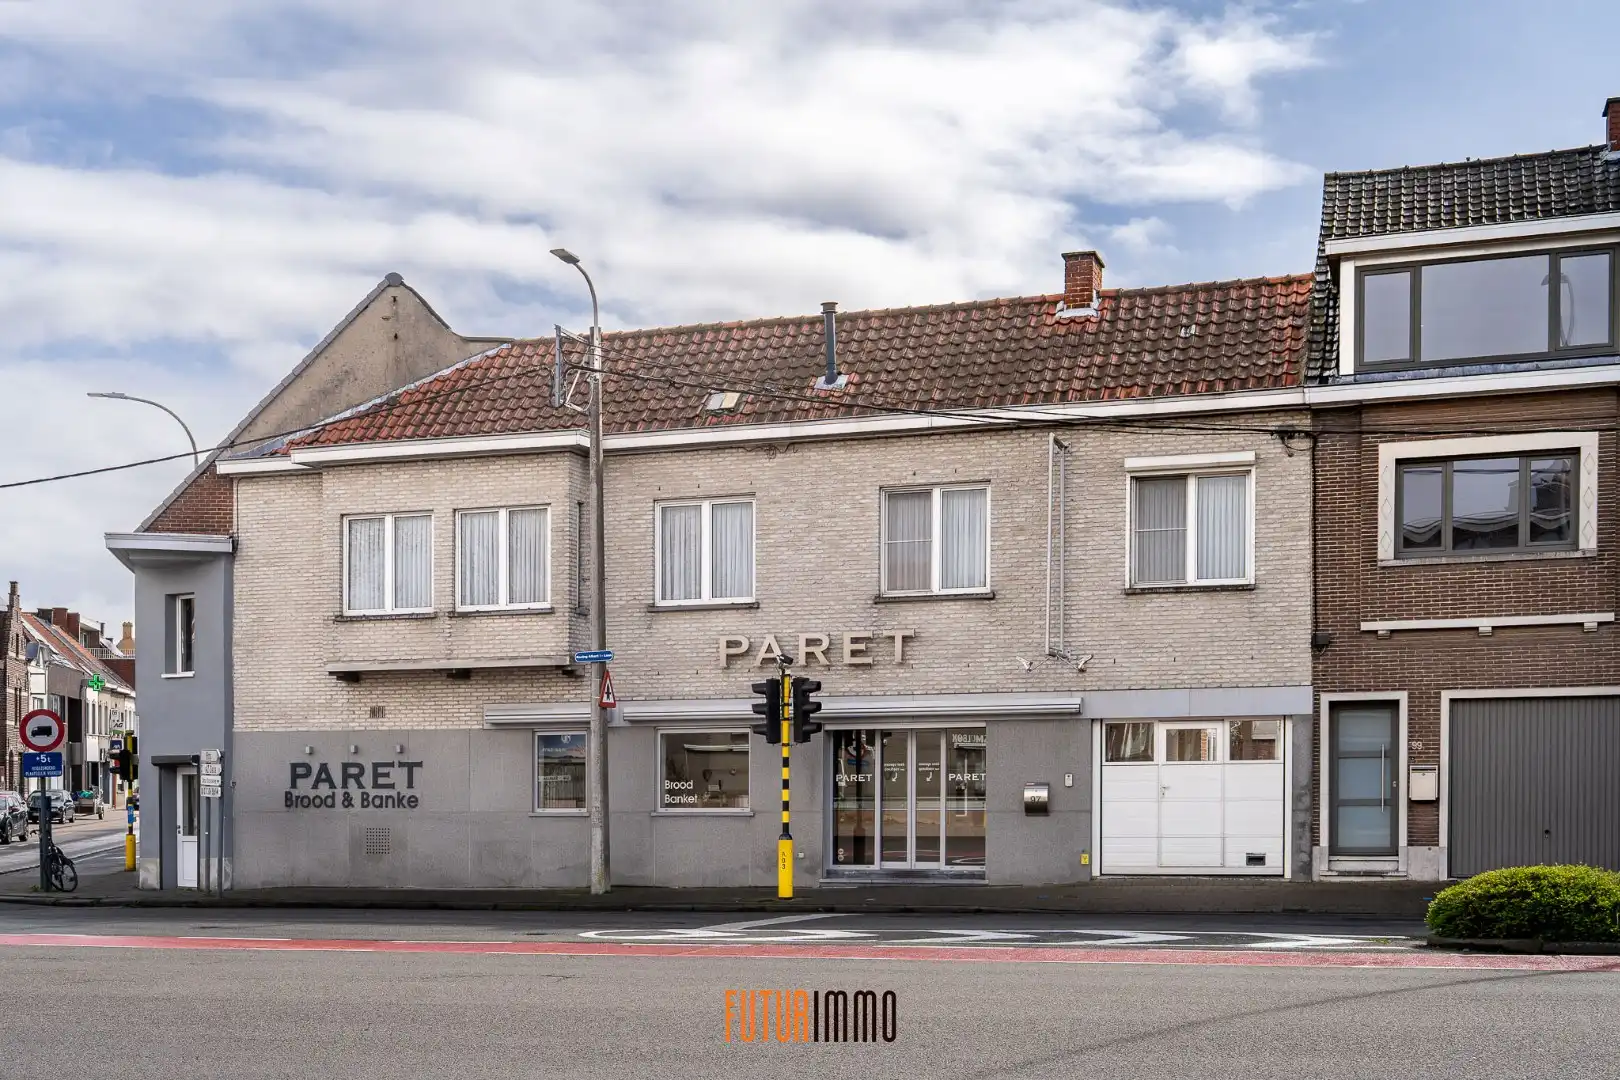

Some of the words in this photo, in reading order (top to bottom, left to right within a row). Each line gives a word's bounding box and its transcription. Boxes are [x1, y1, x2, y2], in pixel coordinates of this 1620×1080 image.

[718, 629, 915, 668] PARET
[1411, 741, 1423, 750] 99
[289, 761, 423, 789] PARET
[835, 774, 873, 782] PARET
[948, 773, 986, 781] PARET
[664, 779, 694, 790] Brood
[284, 791, 336, 809] Brood
[341, 791, 355, 809] &
[360, 791, 418, 809] Banke
[664, 793, 698, 804] Banket
[1030, 795, 1042, 804] 97
